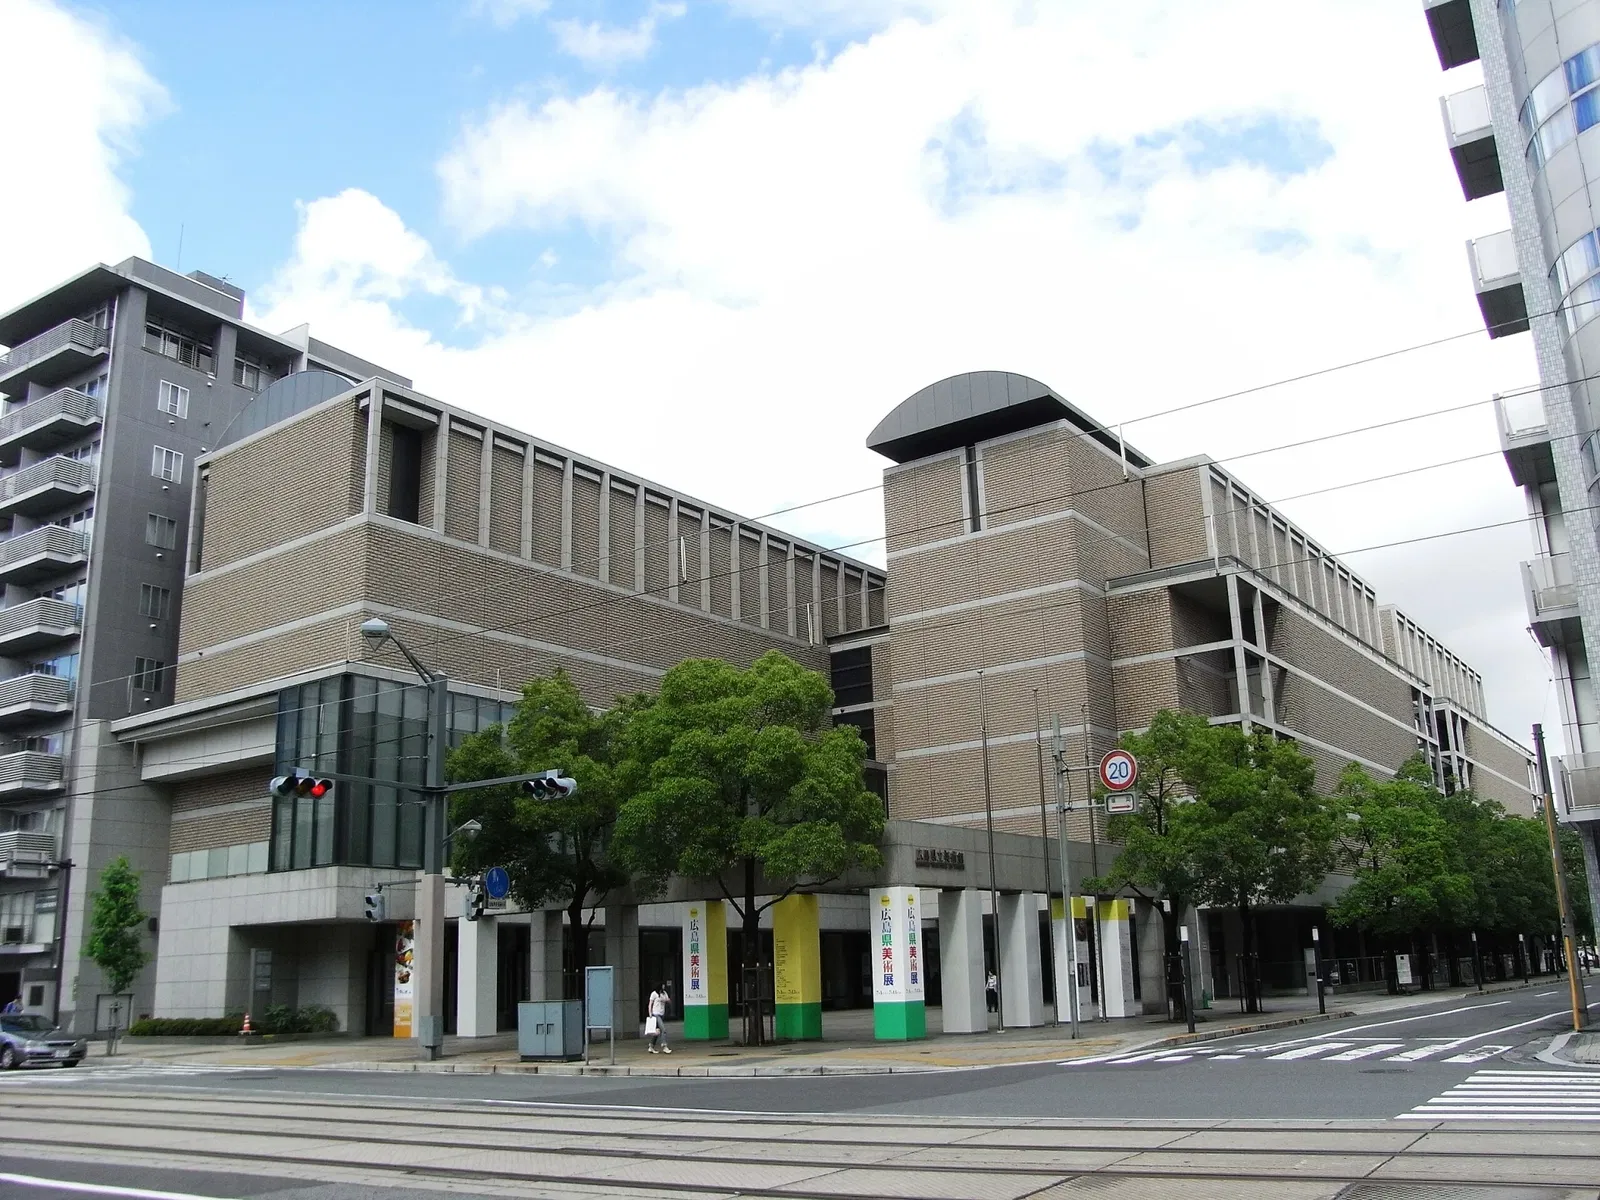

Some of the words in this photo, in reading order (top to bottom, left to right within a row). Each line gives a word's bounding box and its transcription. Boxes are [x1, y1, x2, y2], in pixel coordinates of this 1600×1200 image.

[1108, 761, 1129, 780] 20
[690, 919, 700, 990] 広島県美術展
[881, 907, 894, 986] 広島県美術展
[907, 906, 918, 985] 広島県美術展
